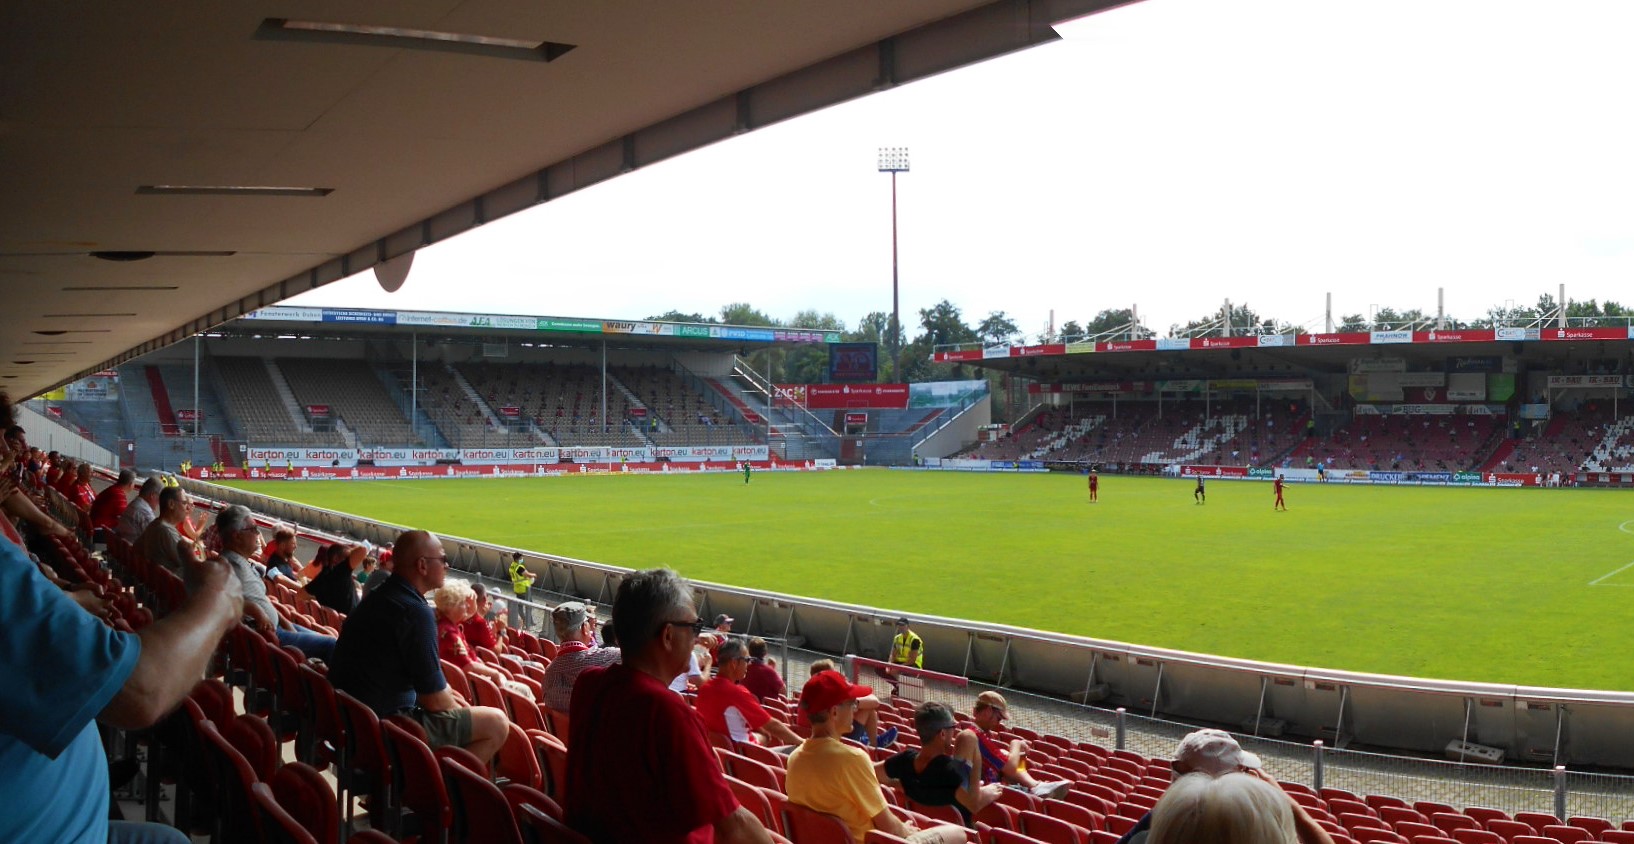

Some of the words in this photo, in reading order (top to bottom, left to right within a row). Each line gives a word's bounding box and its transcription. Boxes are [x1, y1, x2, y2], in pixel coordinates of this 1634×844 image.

[607, 322, 636, 331] waury
[682, 327, 709, 336] ARCUS
[774, 388, 793, 398] ZAC
[251, 450, 299, 459] karton.eu
[306, 450, 353, 459] karton.eu
[360, 450, 405, 459] karton.eu
[412, 450, 457, 459] karton.eu
[463, 450, 507, 459] karton.eu
[559, 449, 601, 457] karton.eu
[651, 448, 688, 456] karton.eu
[692, 447, 727, 456] karton.eu
[732, 447, 766, 455] karton.eu
